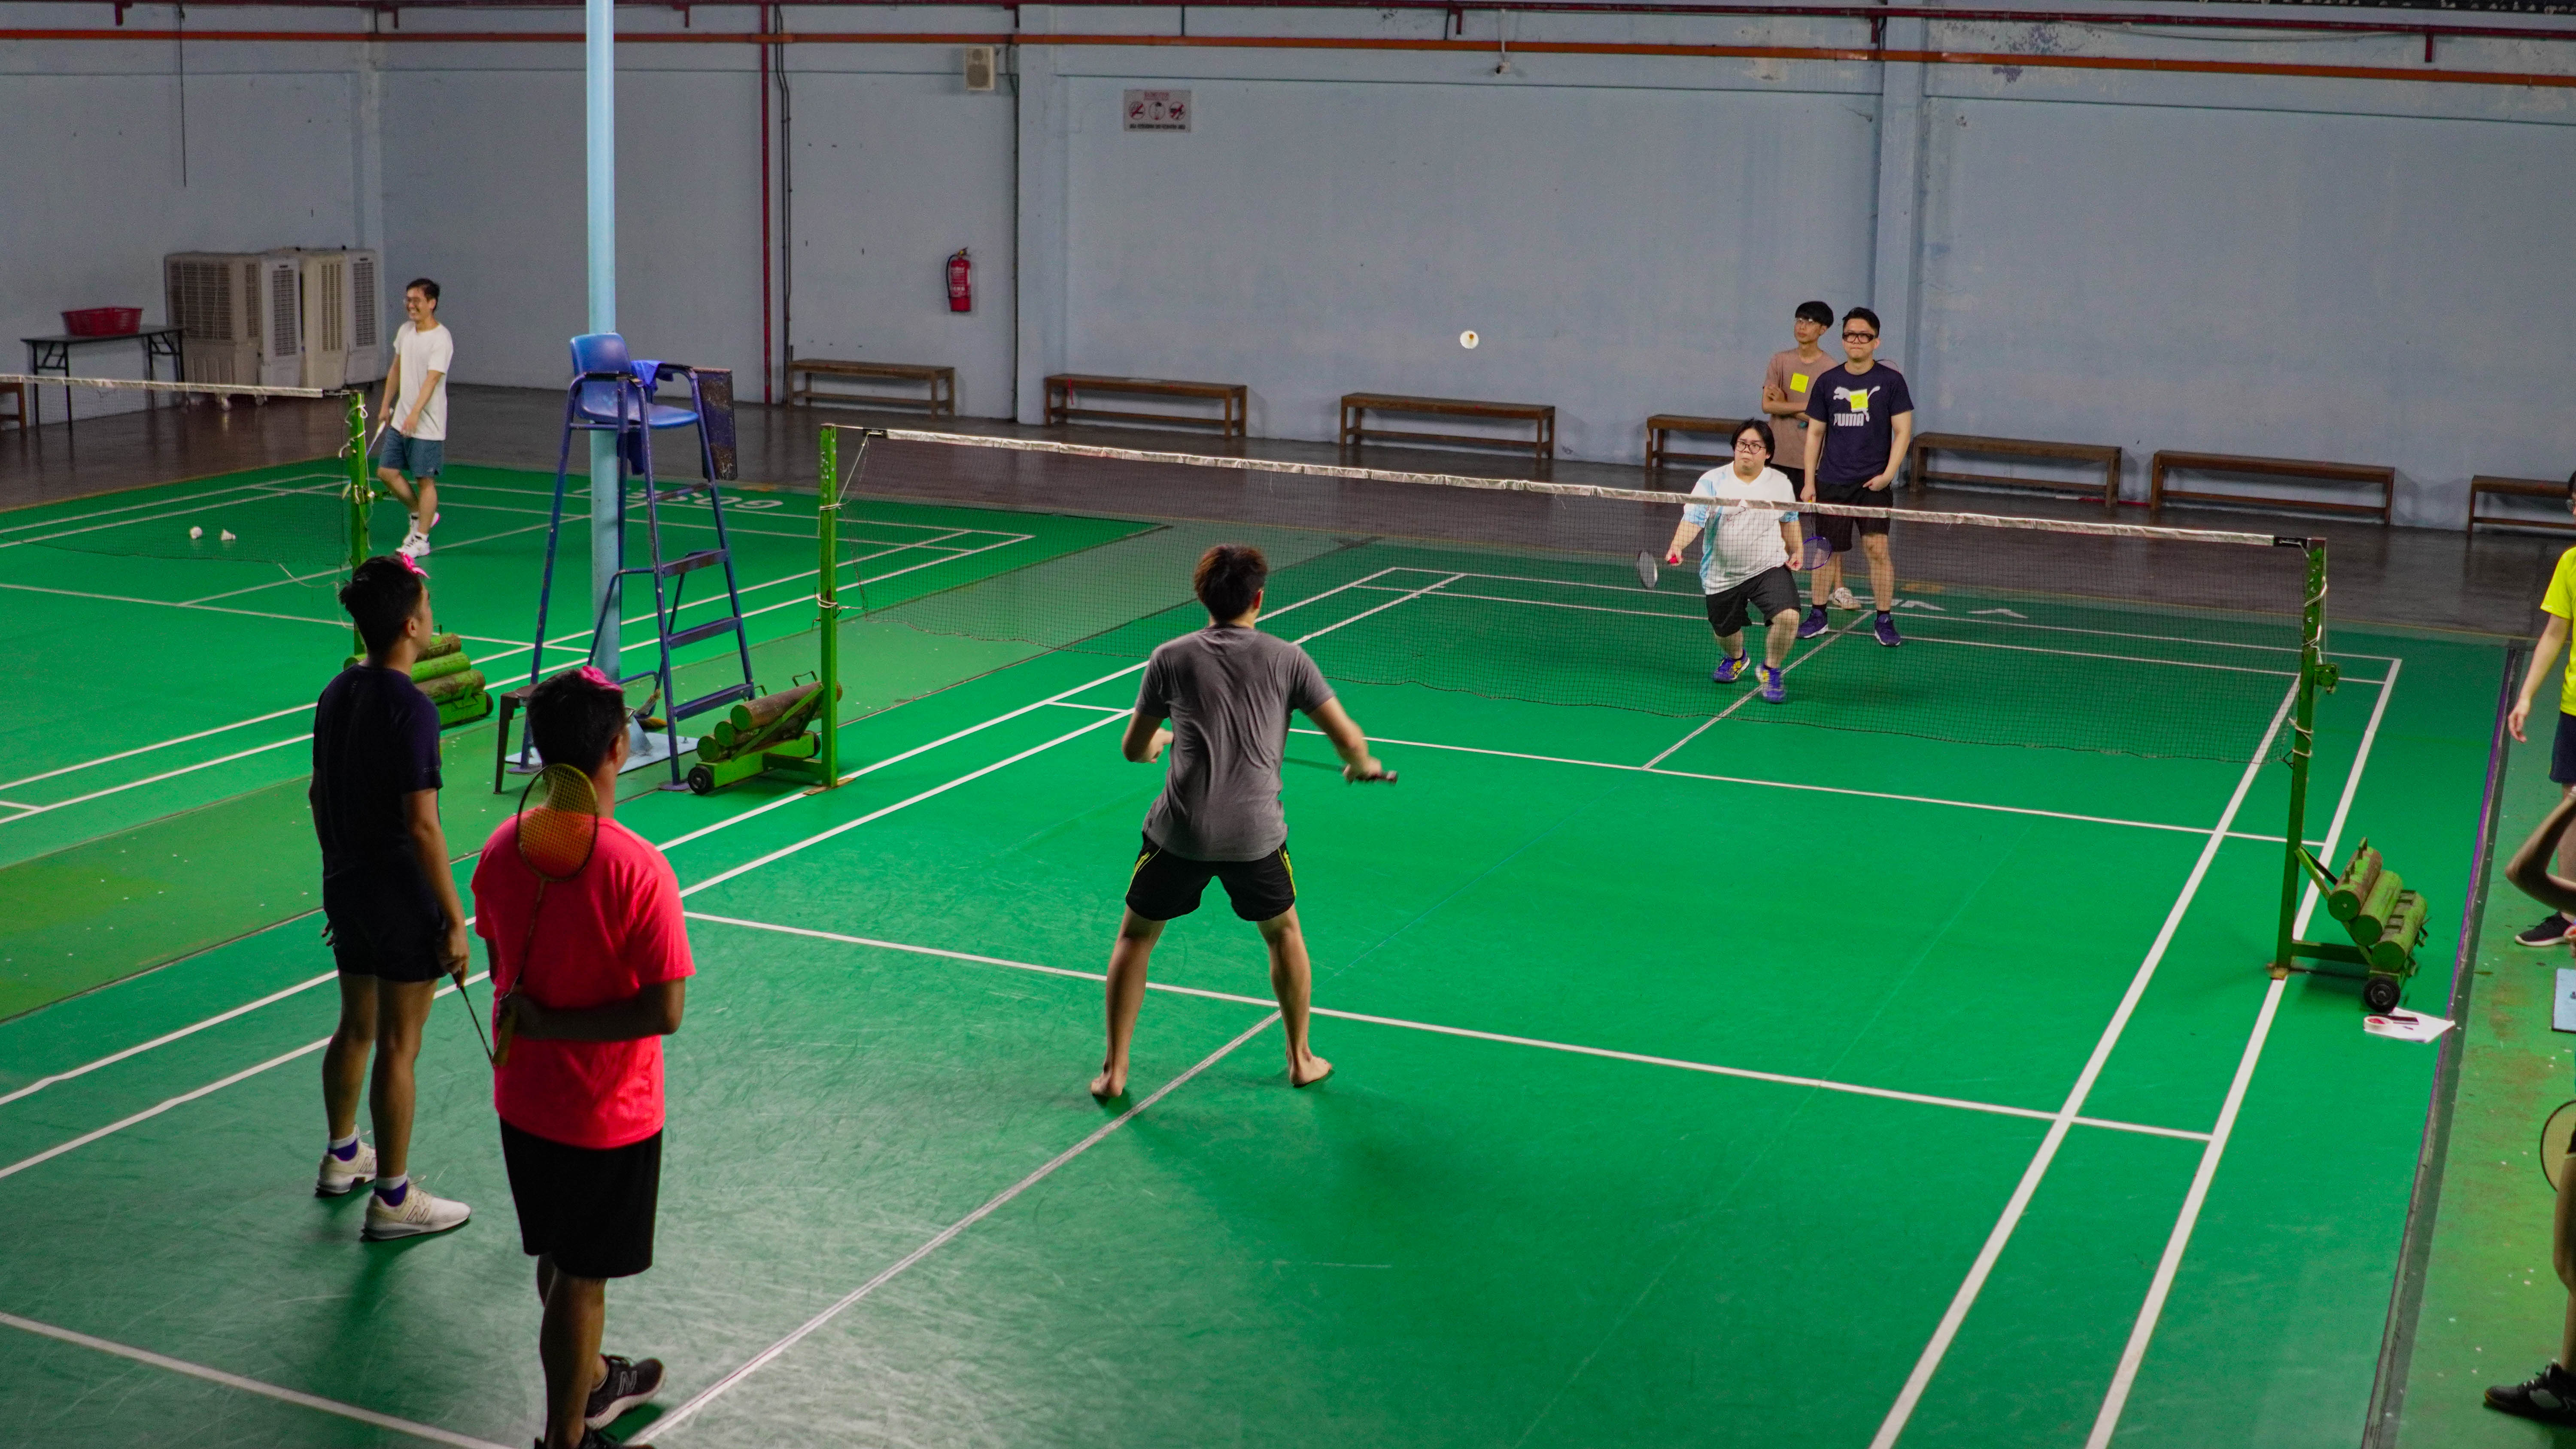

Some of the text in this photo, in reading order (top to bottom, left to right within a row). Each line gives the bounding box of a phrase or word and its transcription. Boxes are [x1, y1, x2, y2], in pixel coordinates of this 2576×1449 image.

[1833, 413, 1864, 427] PUMA
[406, 1205, 430, 1224] N
[617, 1370, 638, 1396] N
